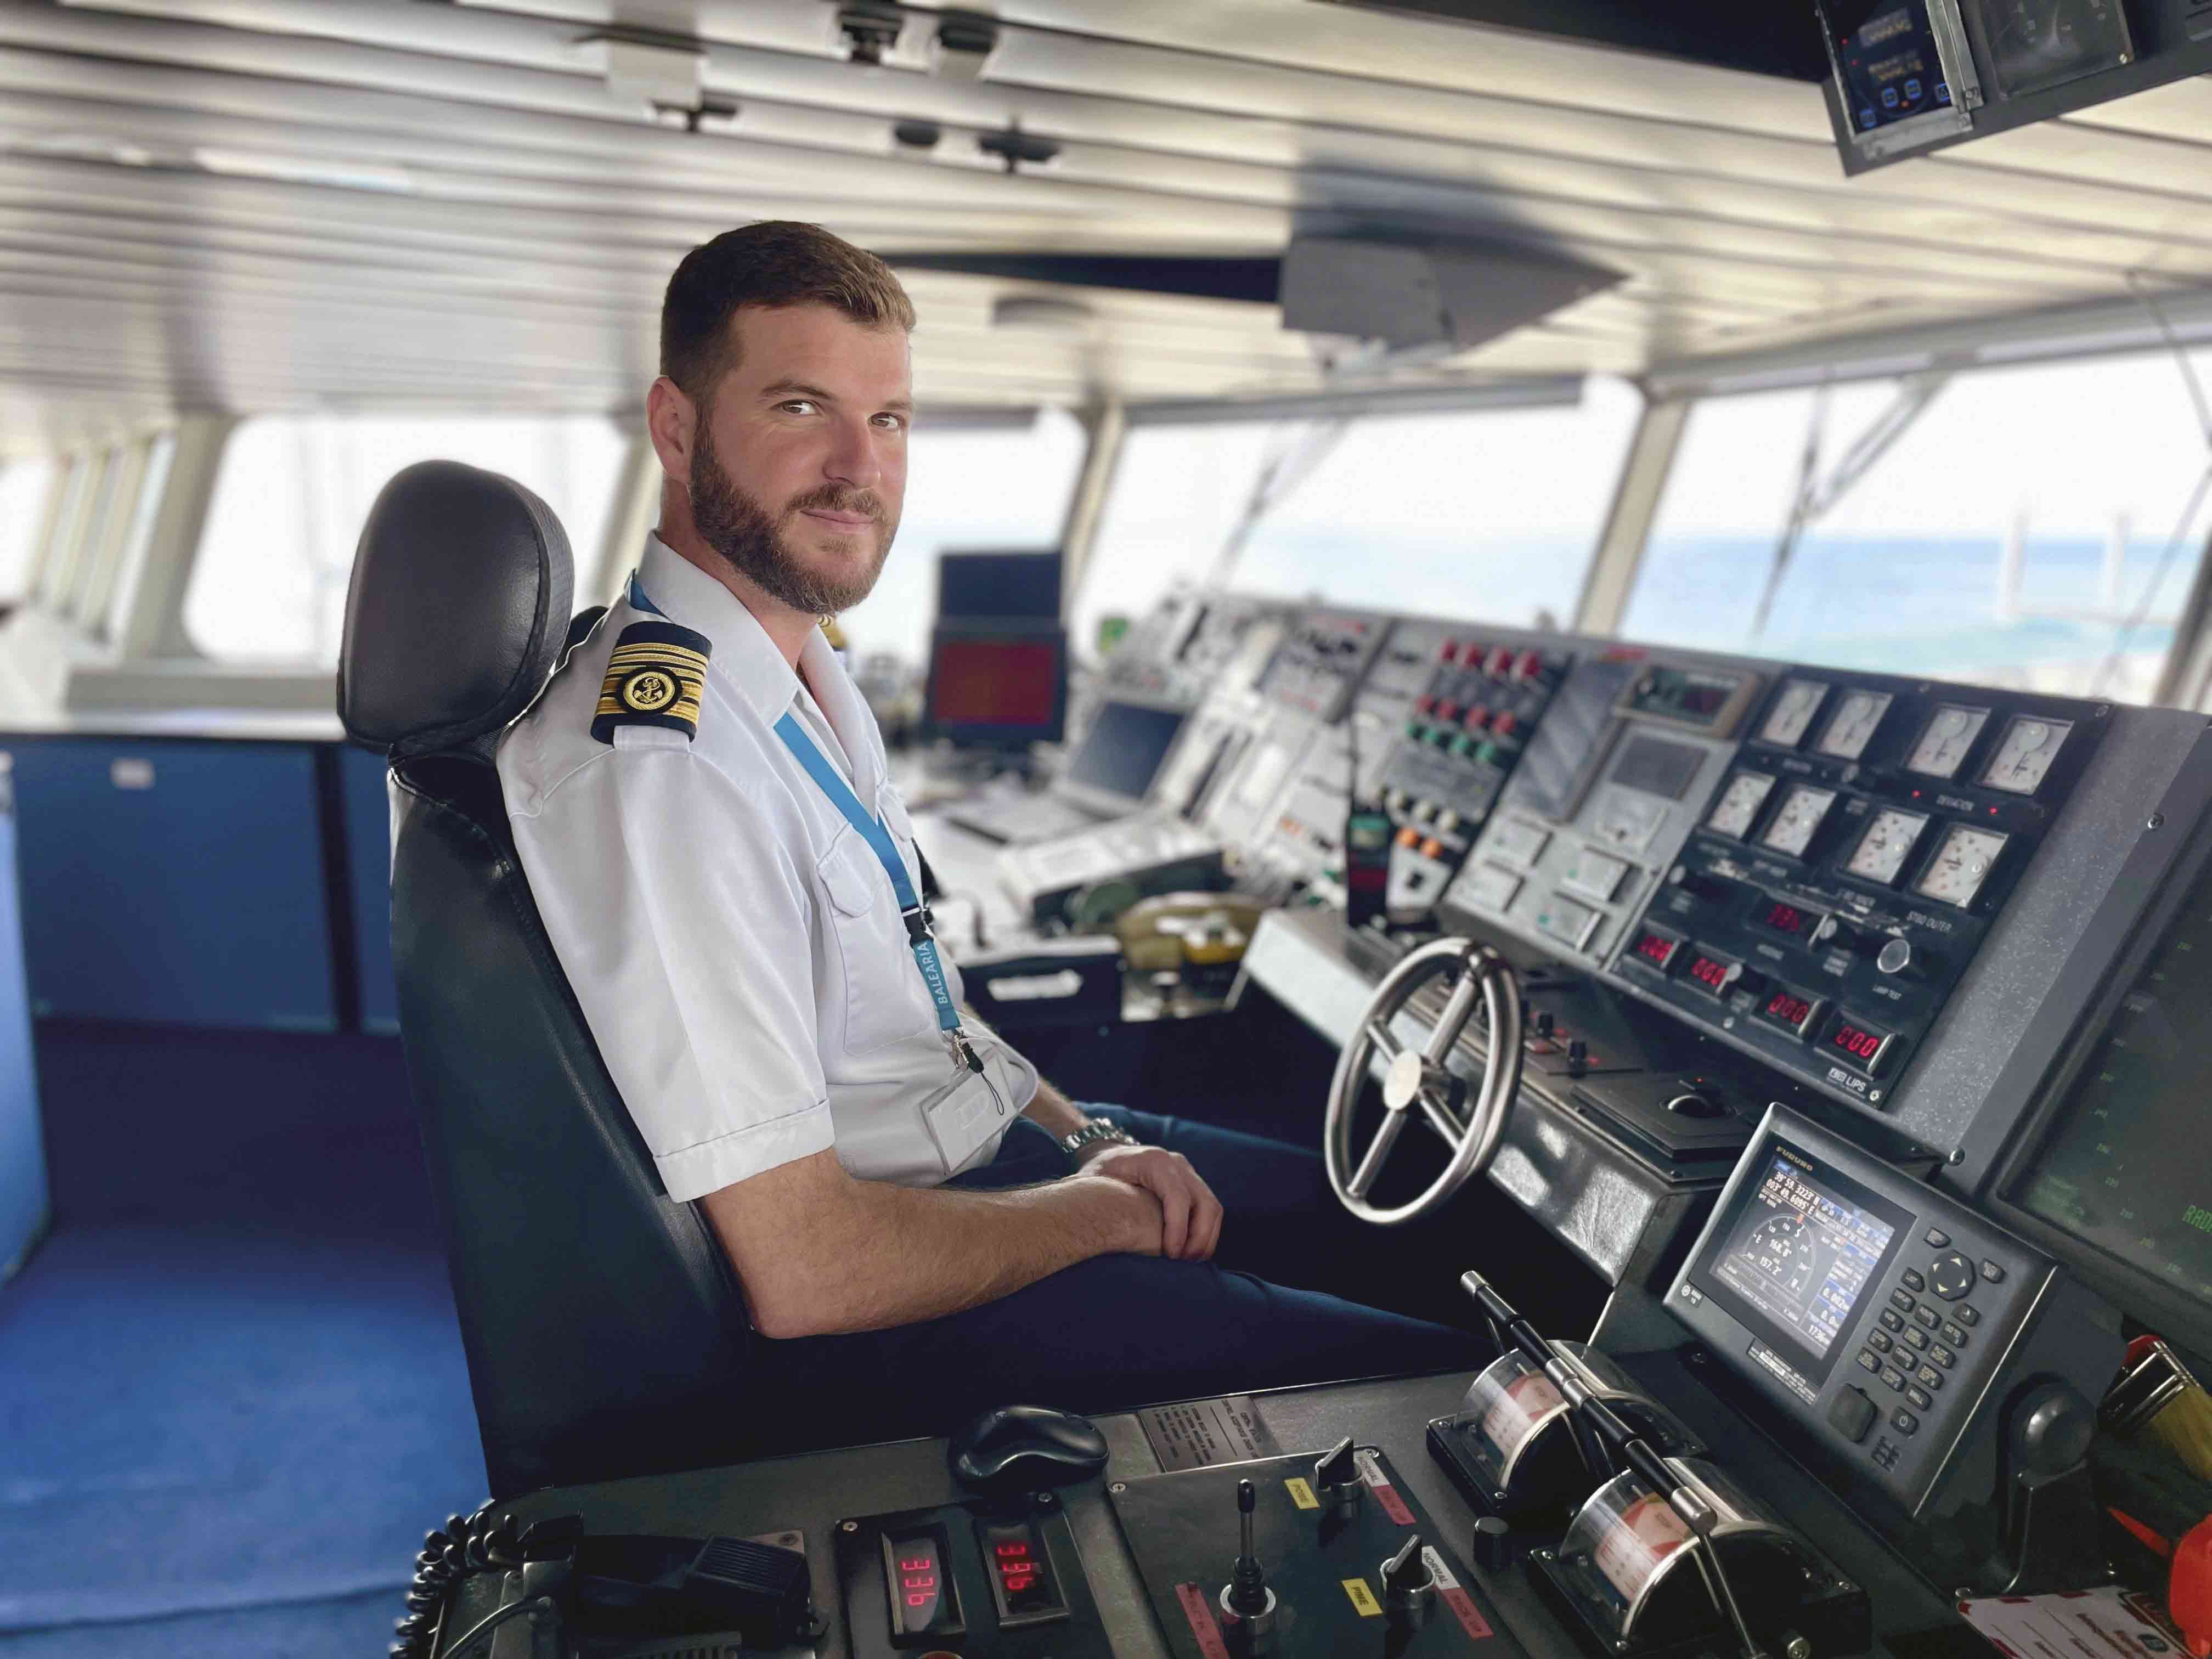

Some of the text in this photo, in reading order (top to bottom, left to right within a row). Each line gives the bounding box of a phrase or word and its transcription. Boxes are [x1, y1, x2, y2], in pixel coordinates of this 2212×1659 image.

[917, 942, 949, 1004] BALEARIA
[1835, 1025, 1879, 1058] 000
[1846, 1075, 1867, 1092] LIPS
[900, 1557, 936, 1607] 336
[1423, 1551, 1449, 1585] NORMAL
